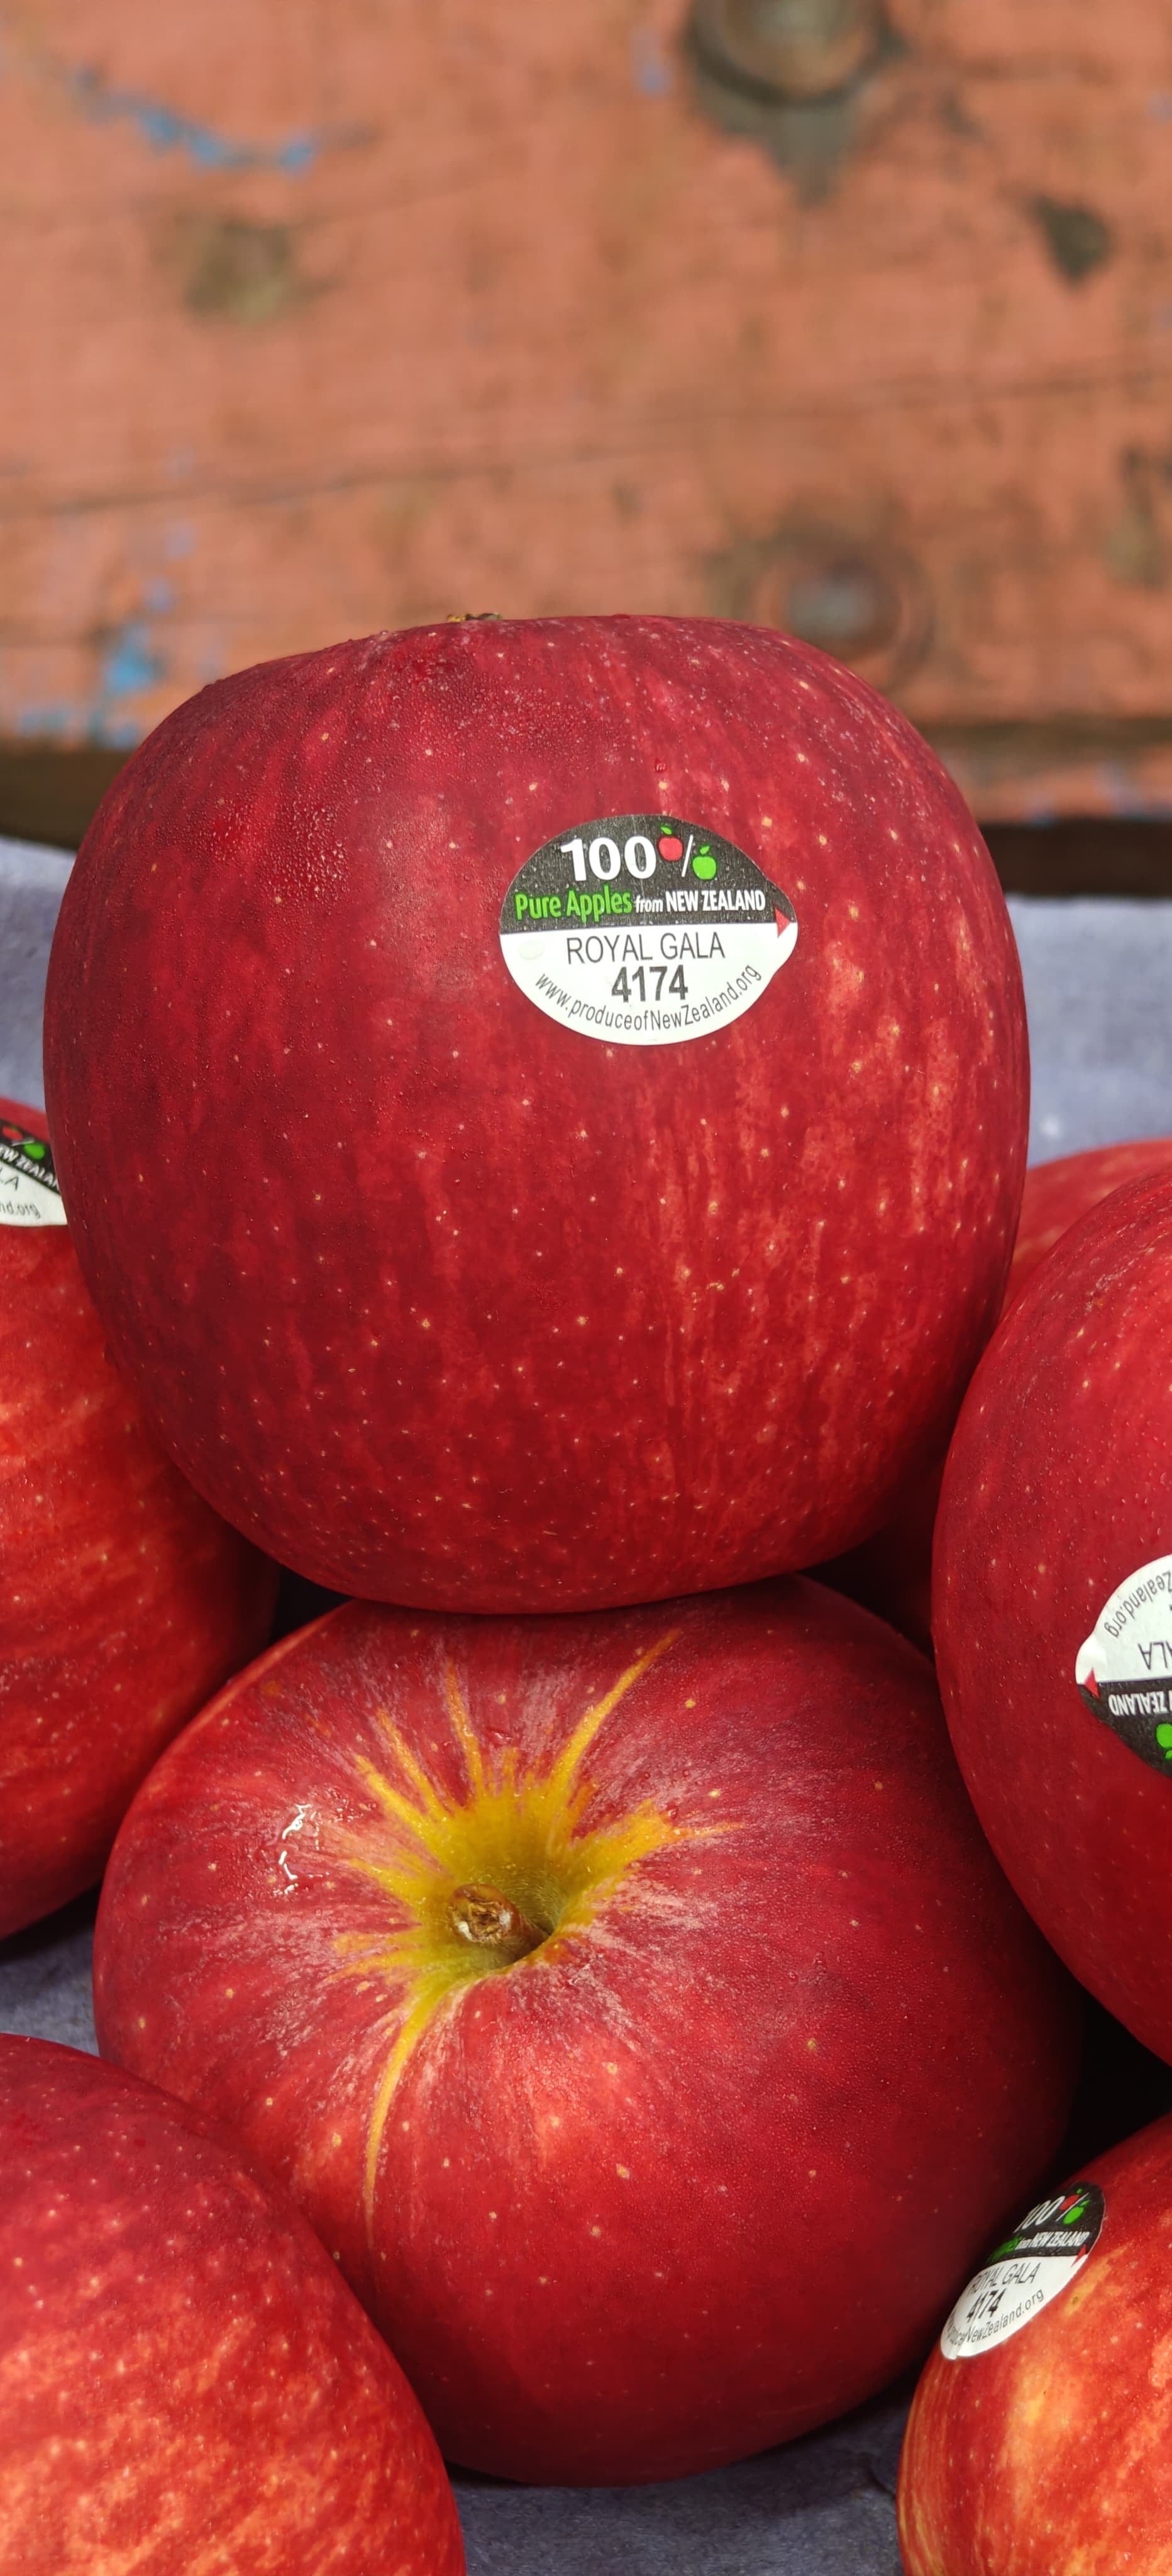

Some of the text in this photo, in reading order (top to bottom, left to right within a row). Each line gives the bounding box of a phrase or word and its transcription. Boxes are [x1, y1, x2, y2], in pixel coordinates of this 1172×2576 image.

[514, 884, 766, 922] Pure Apples from NEW ZEALAND
[566, 931, 726, 965] ROYAL GALA
[534, 963, 762, 1031] www.produceofNewZealand.org
[611, 964, 688, 1003] 4174
[1108, 1690, 1168, 1716] ZEALAND
[1046, 2231, 1091, 2247] ZEALAND
[1002, 2262, 1042, 2285] GALA
[966, 2288, 1007, 2323] 4174
